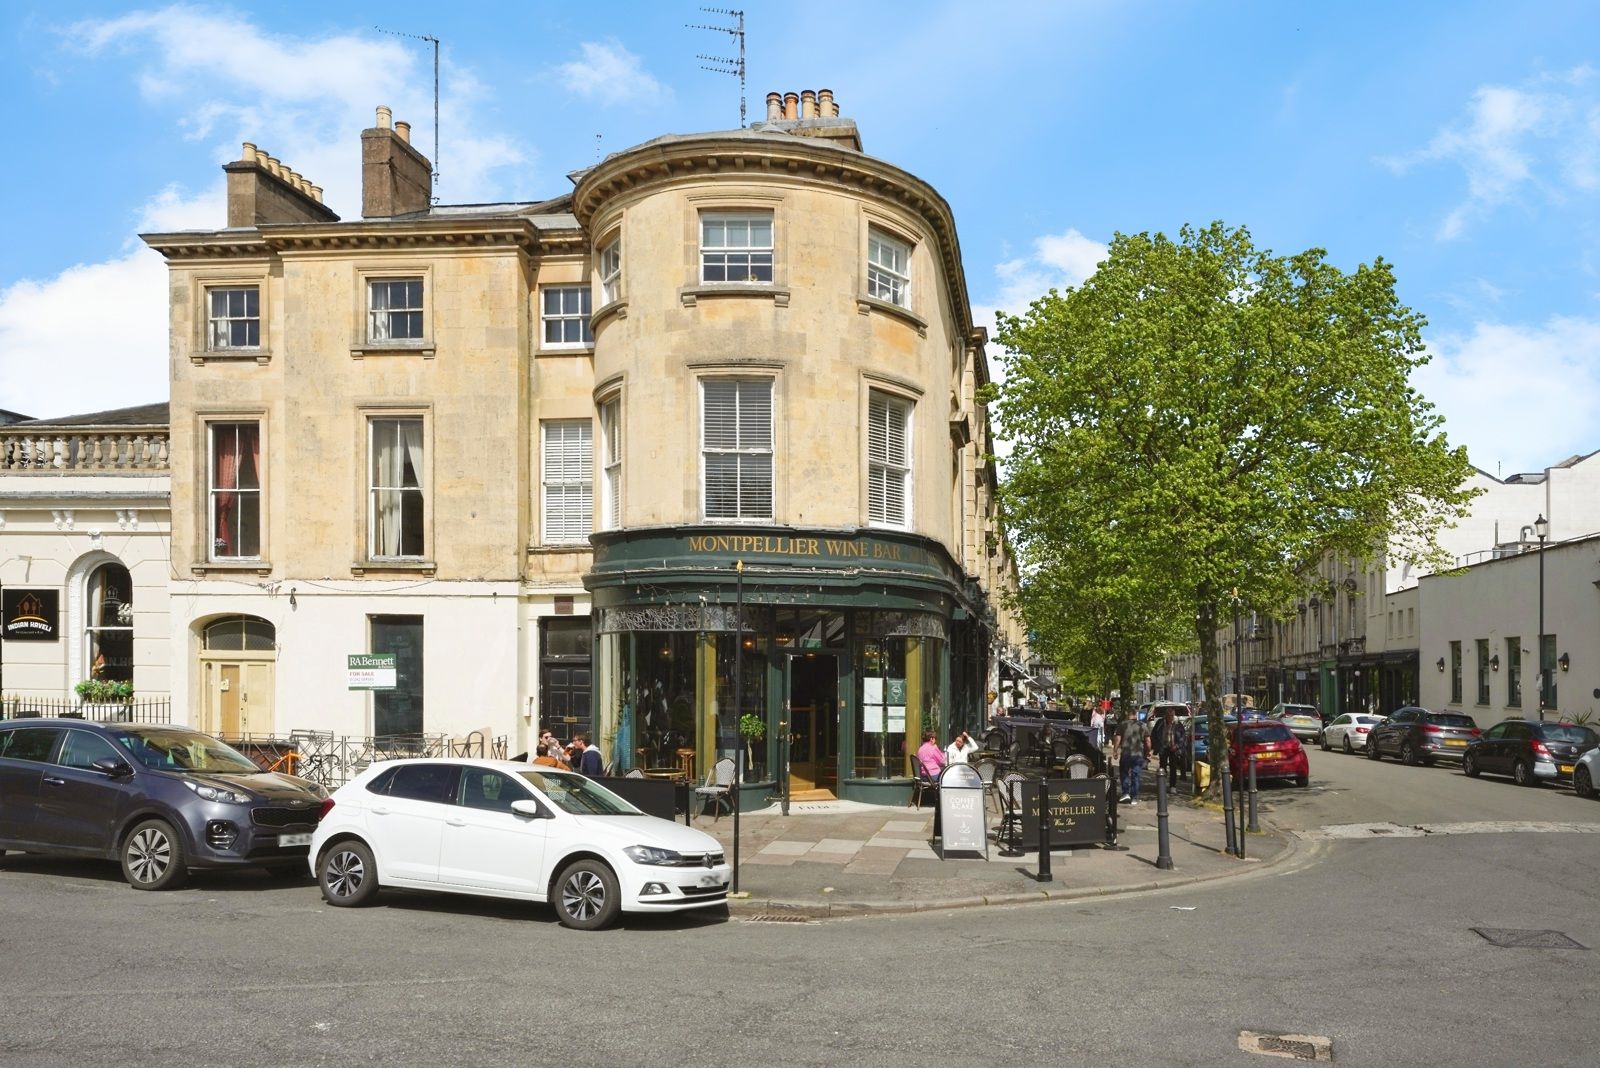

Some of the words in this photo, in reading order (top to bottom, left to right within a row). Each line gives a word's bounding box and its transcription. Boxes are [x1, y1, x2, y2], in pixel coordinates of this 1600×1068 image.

[688, 535, 821, 556] MONTPELLIER
[825, 540, 869, 558] WINE
[873, 542, 900, 560] BAR
[7, 621, 29, 631] INDIAN
[361, 656, 394, 666] Bennett
[1032, 806, 1096, 817] MNTPELLIER
